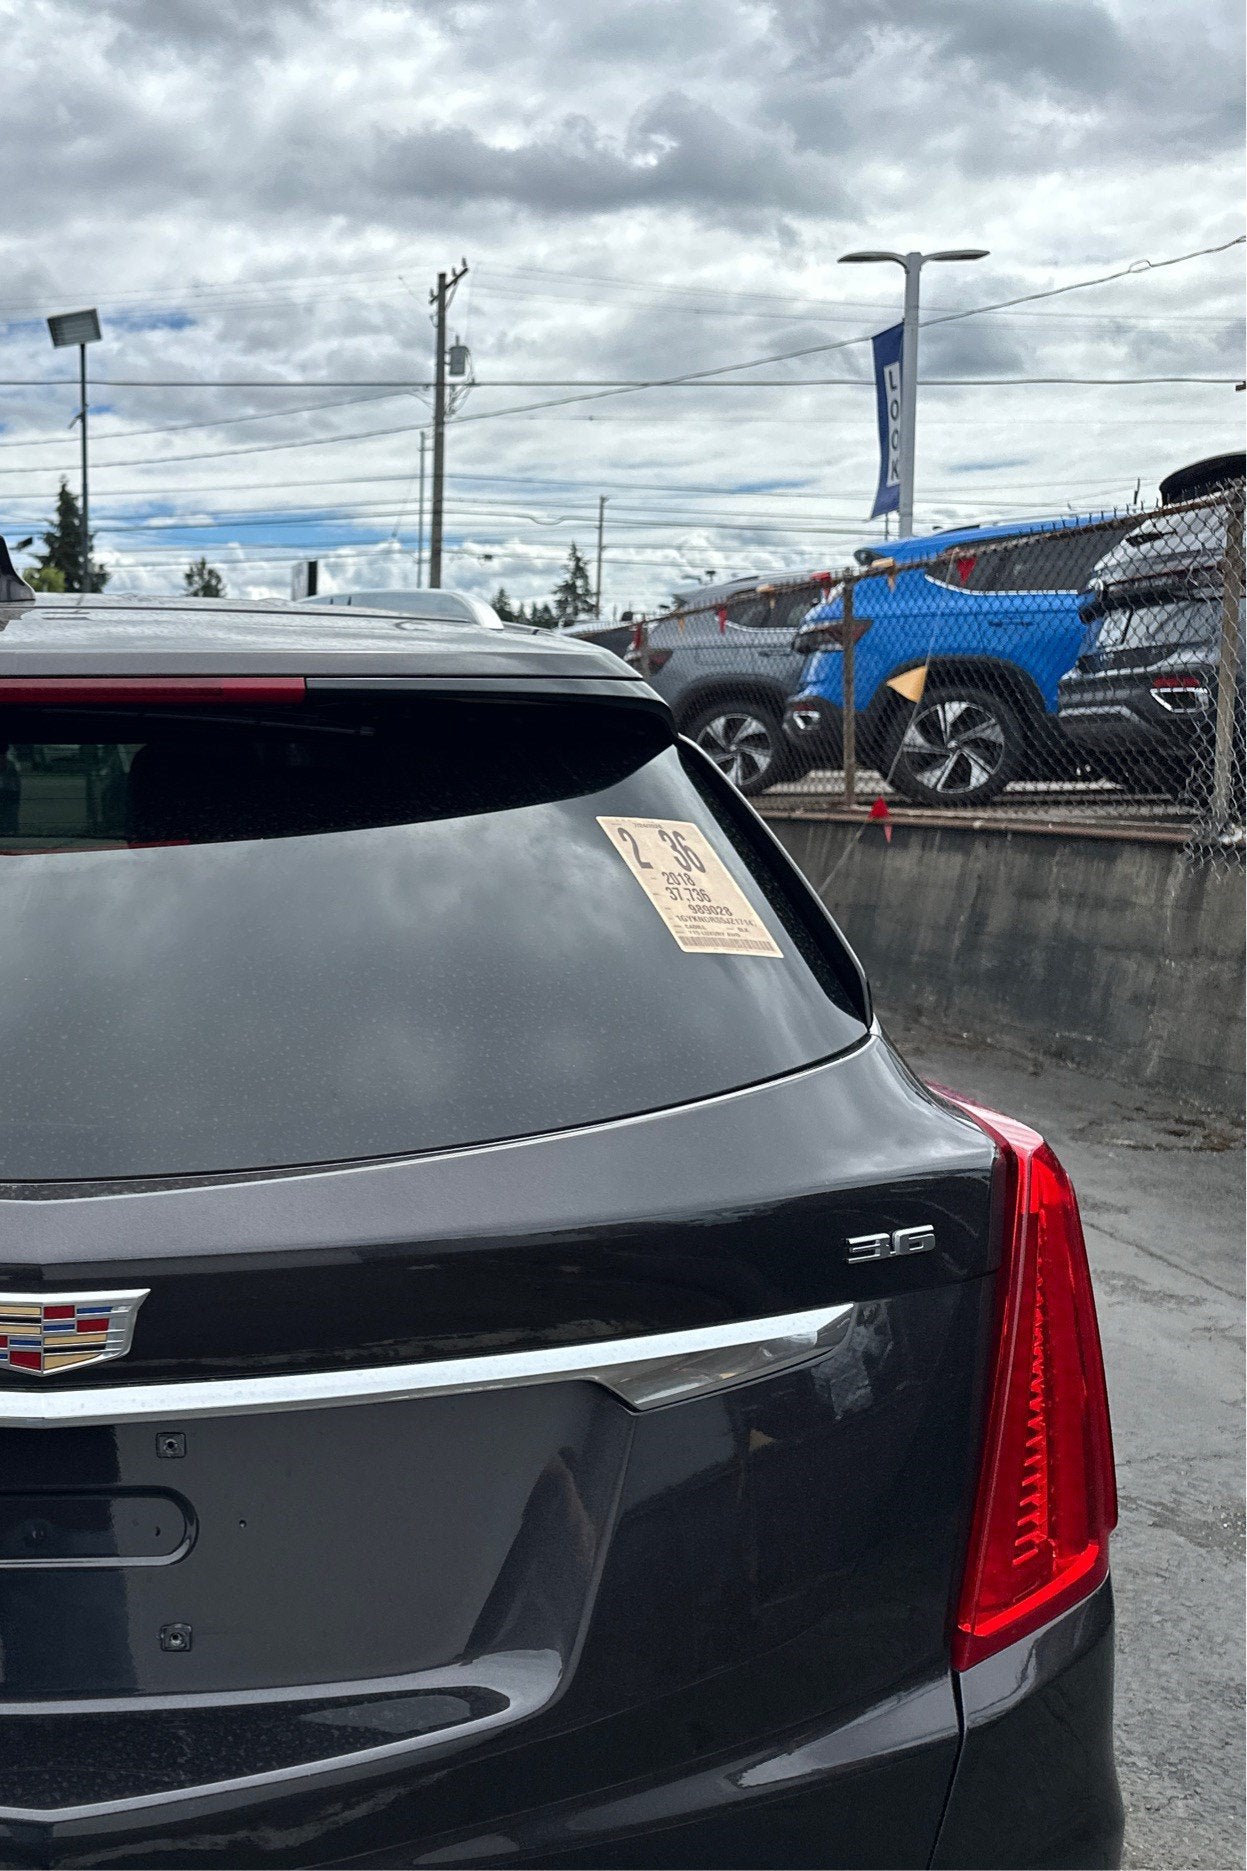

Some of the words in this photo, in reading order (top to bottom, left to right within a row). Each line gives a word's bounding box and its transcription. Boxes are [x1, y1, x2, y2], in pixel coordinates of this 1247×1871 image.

[888, 370, 899, 481] LOCK
[617, 827, 654, 869] 2
[658, 829, 706, 873] 36
[661, 872, 696, 886] 2018
[688, 904, 733, 917] 989028
